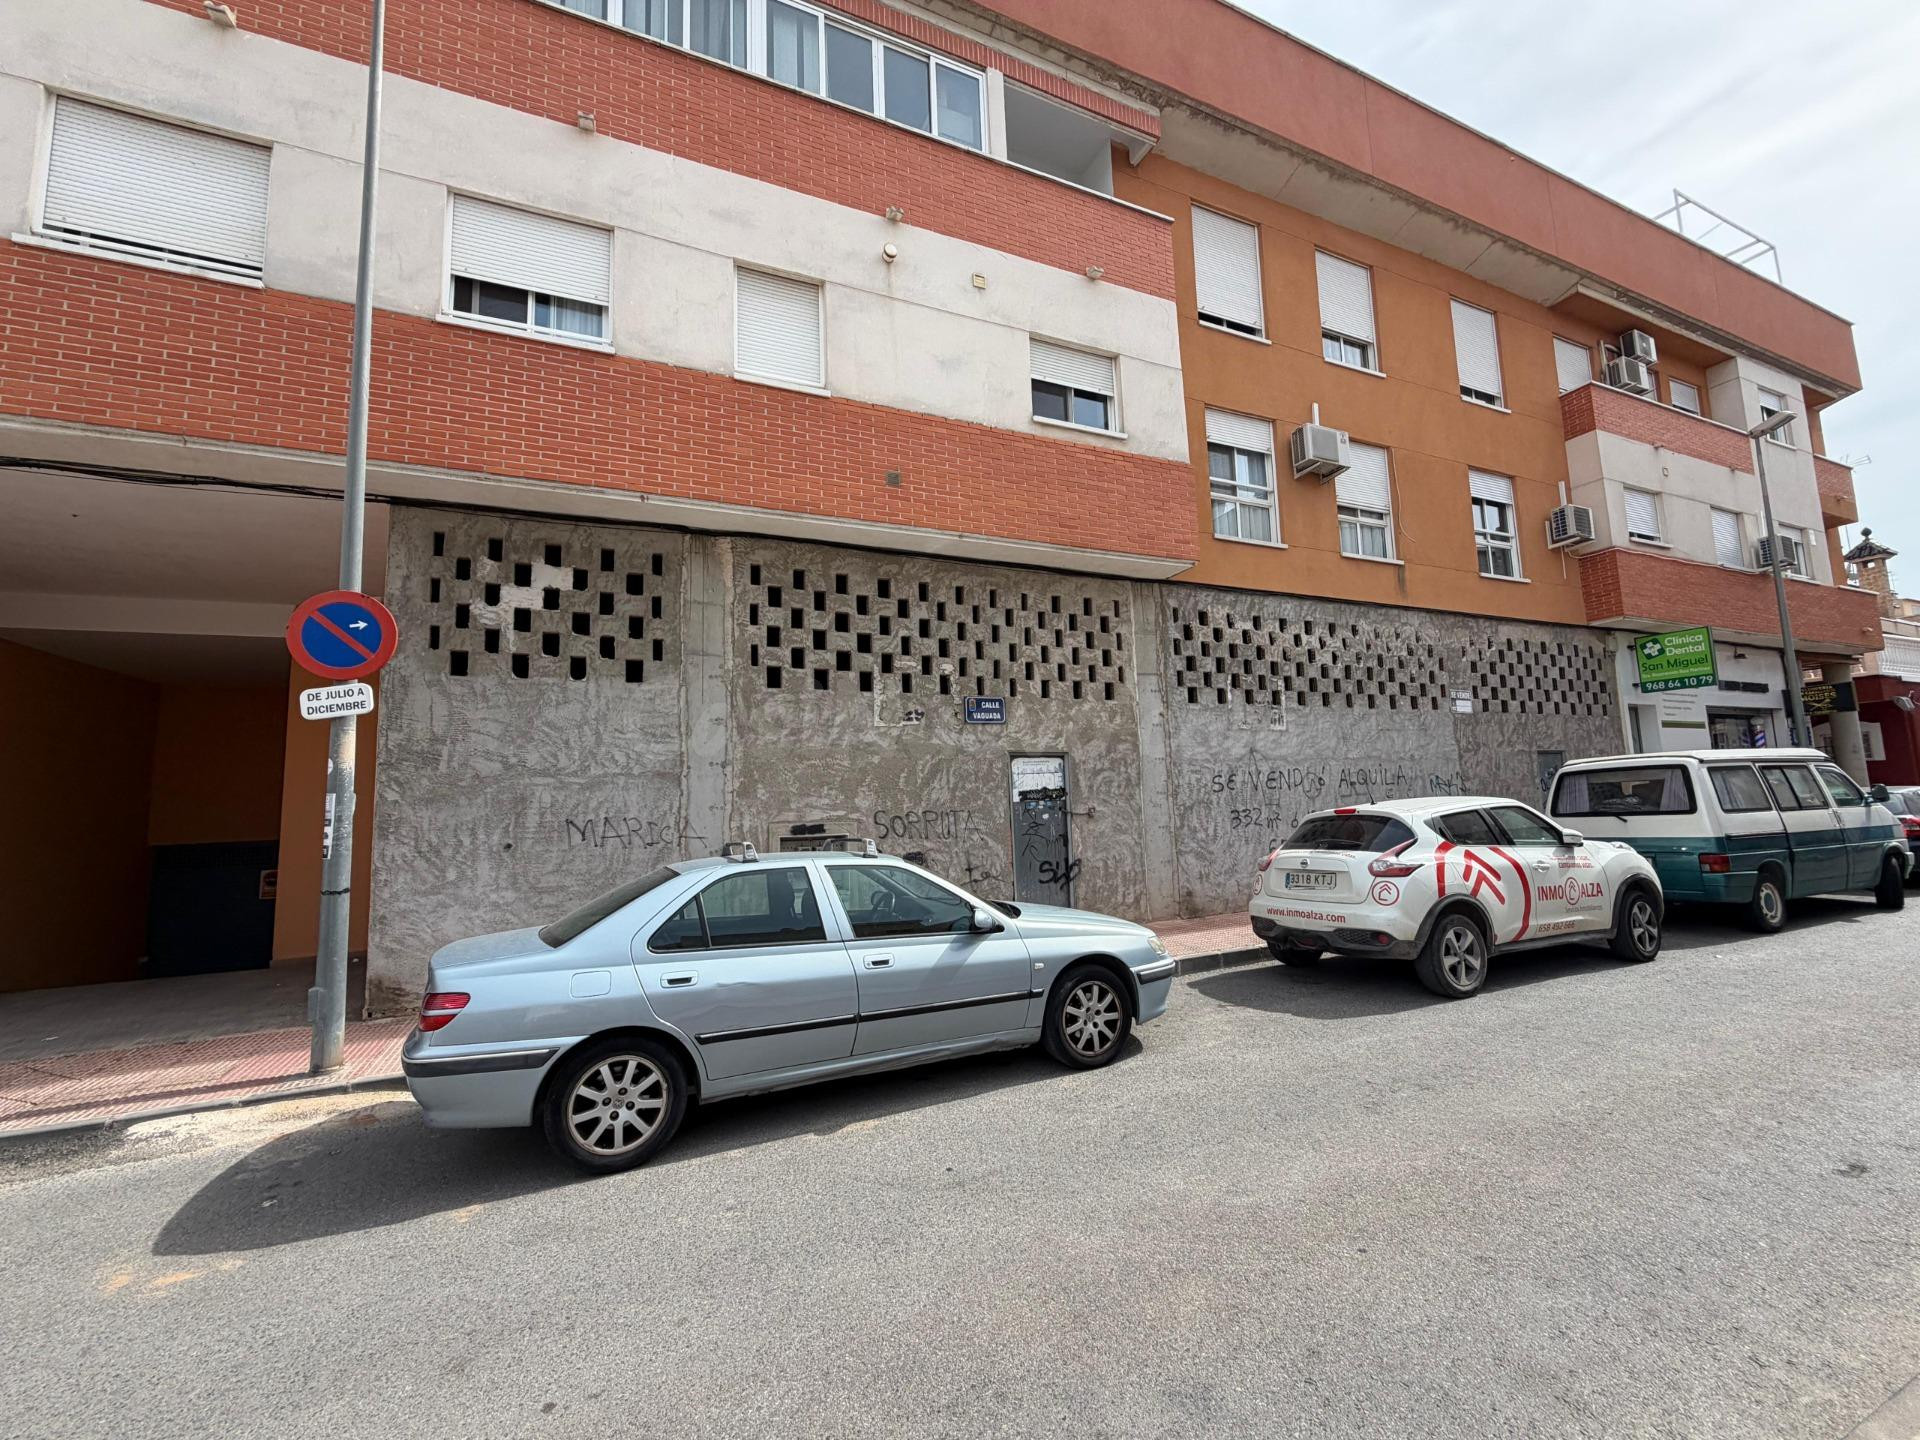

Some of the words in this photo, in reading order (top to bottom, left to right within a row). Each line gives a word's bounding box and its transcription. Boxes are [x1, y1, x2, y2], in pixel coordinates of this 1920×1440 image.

[1666, 642, 1705, 656] Dental
[1641, 661, 1664, 672] San
[1666, 653, 1709, 668] Miguel
[1646, 681, 1665, 691] 968
[1668, 680, 1681, 689] 64
[1684, 677, 1697, 686] 10
[1699, 675, 1713, 685] 79
[307, 693, 322, 701] DE
[325, 689, 354, 700] JULIO
[357, 688, 364, 696] A
[307, 701, 367, 715] DICIEMBRE
[1212, 774, 1237, 793] SE
[1231, 808, 1262, 829] 332
[565, 816, 708, 849] MARICA
[1291, 873, 1312, 884] 3318
[1314, 874, 1333, 886] KTJ
[1538, 885, 1564, 901] INMO
[1581, 882, 1604, 898] ALZA
[1266, 907, 1346, 924] www.inmoalza.com
